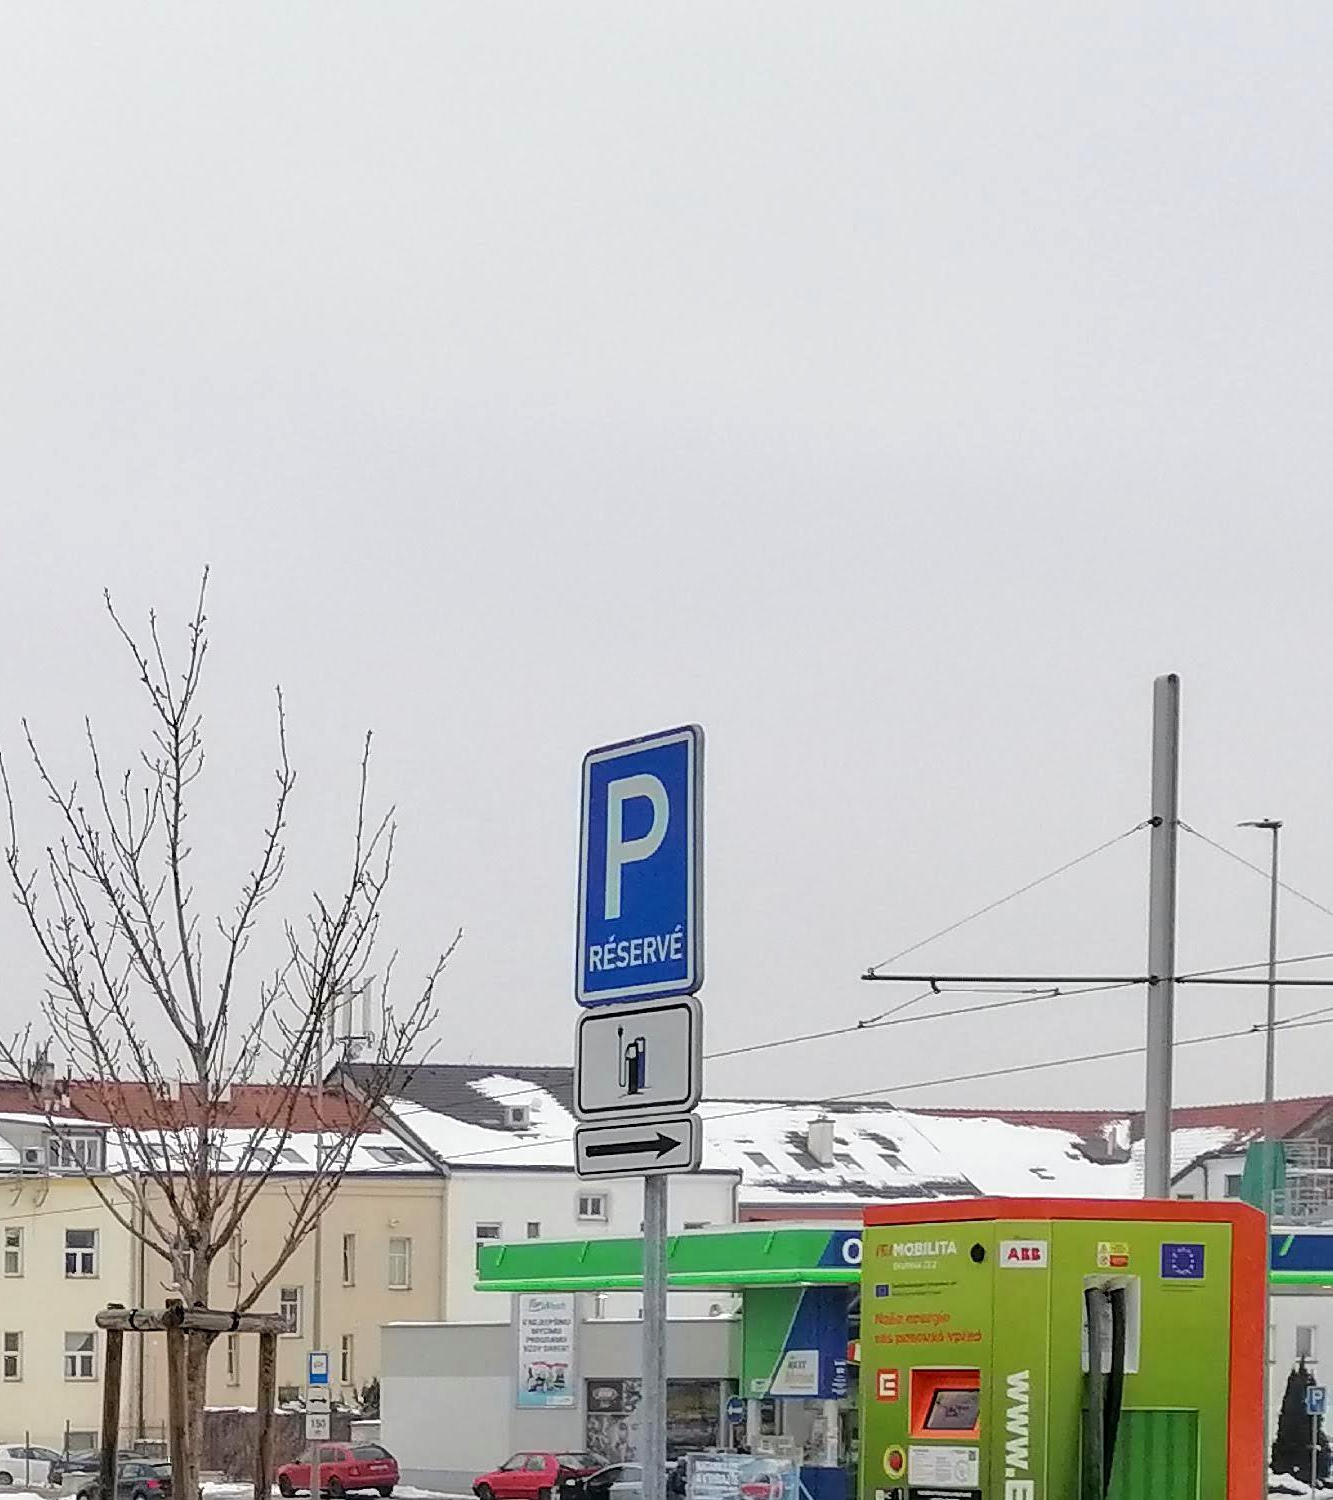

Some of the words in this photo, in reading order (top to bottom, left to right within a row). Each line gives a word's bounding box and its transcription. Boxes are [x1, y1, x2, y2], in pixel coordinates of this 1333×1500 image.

[604, 772, 670, 921] P
[587, 924, 683, 973] RÉSERVÉ
[1007, 1247, 1042, 1262] ABB
